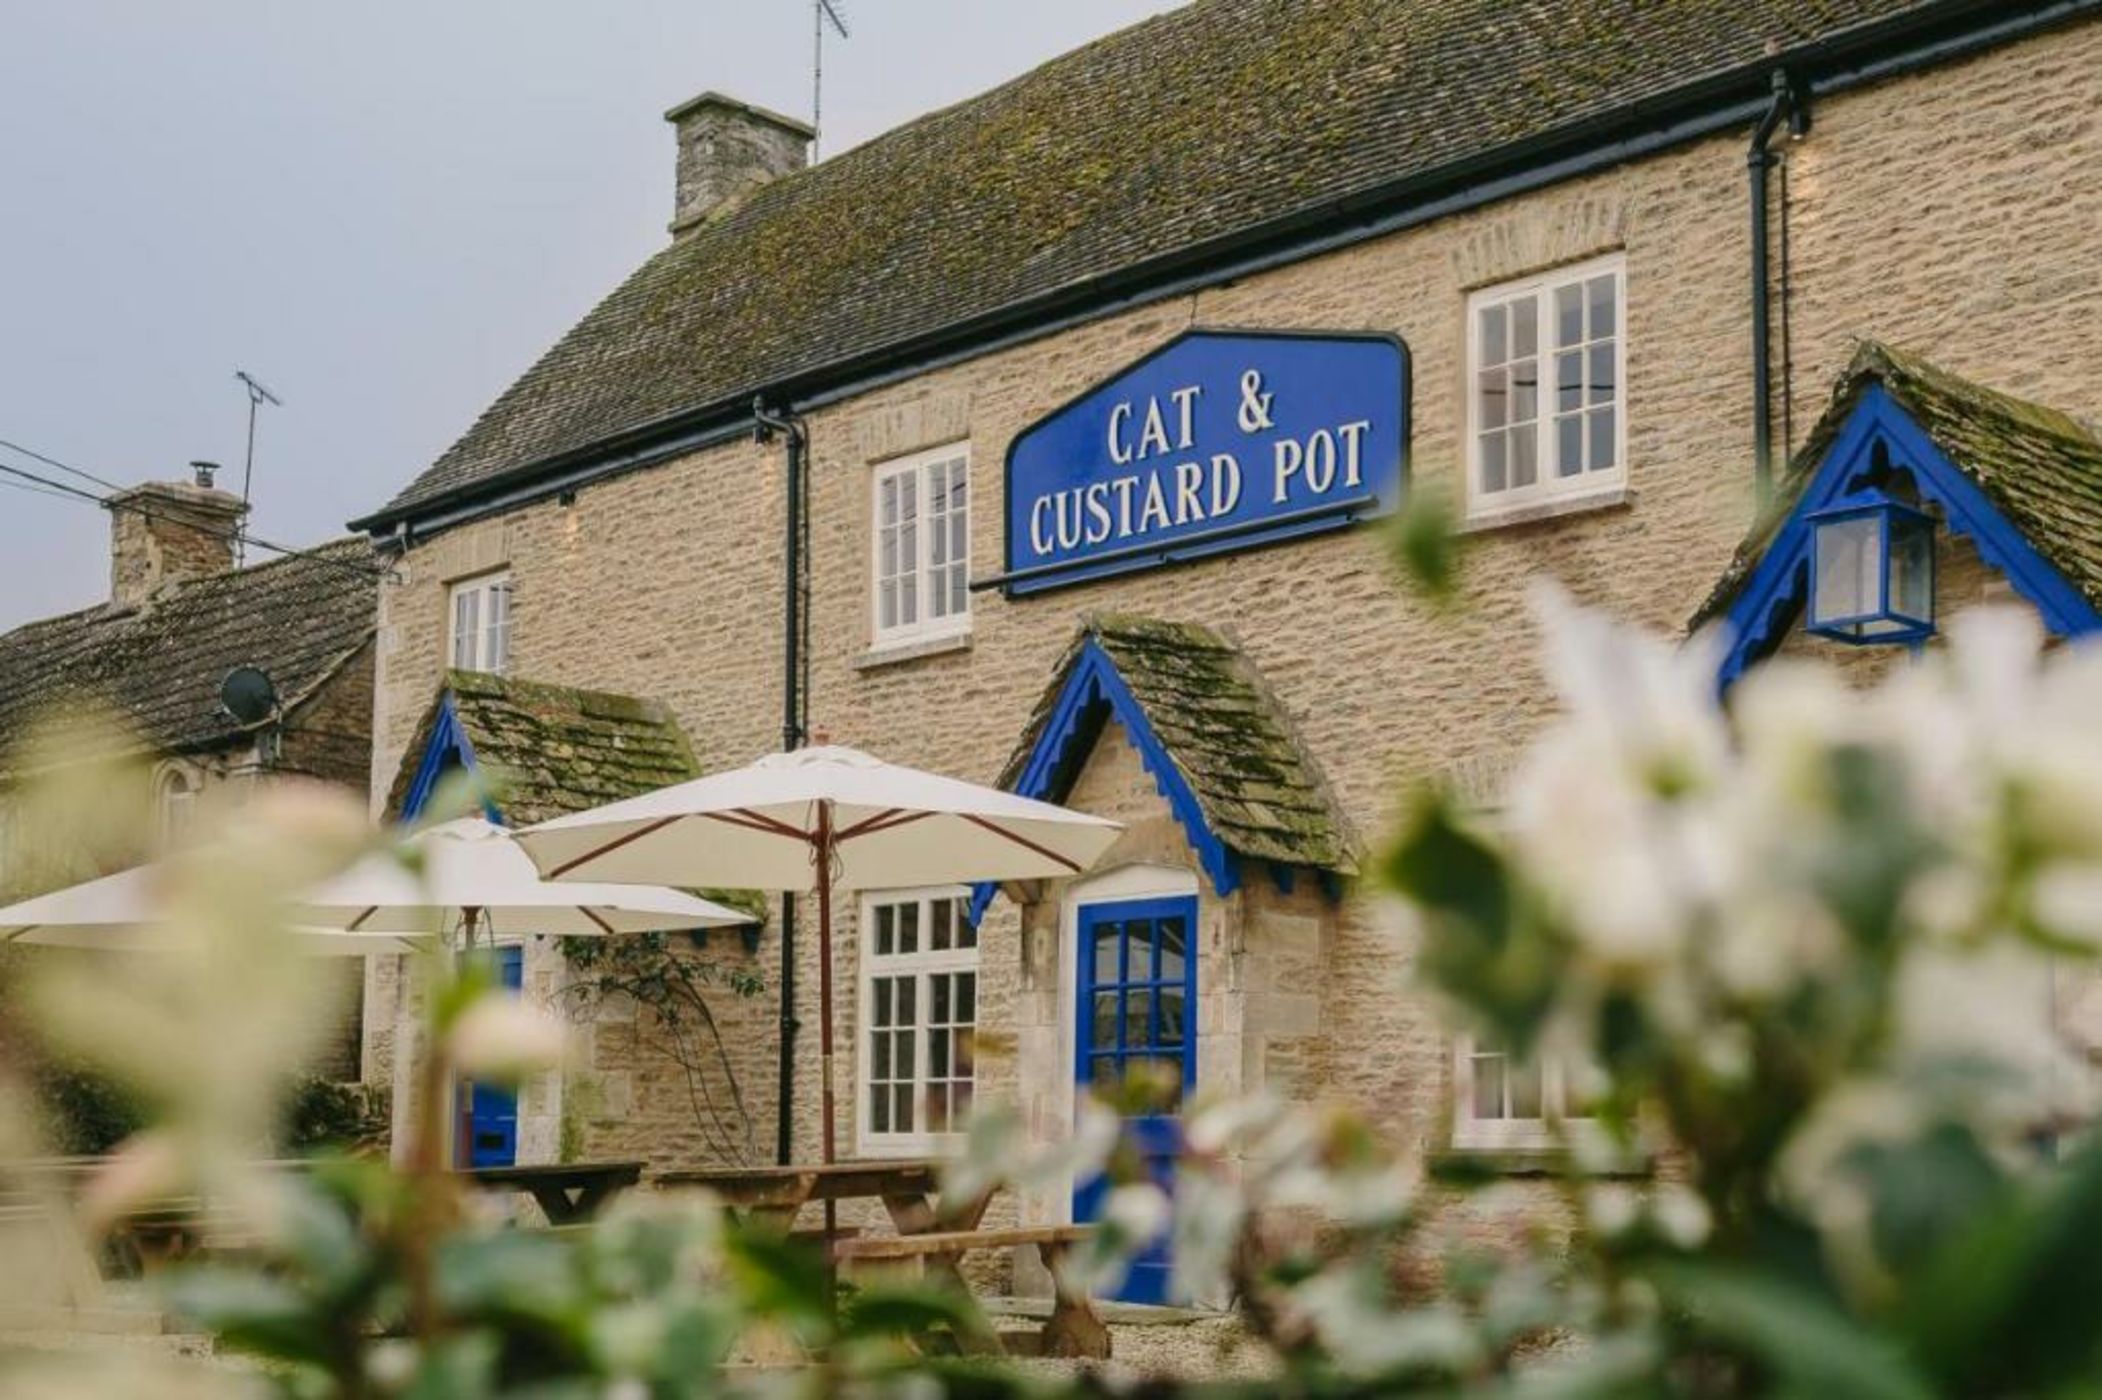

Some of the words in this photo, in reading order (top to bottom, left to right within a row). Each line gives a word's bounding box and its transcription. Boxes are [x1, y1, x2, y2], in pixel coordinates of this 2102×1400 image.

[1108, 386, 1200, 464] CAT
[1238, 369, 1274, 433] &
[1030, 453, 1241, 555] CUSTARD
[1273, 420, 1370, 503] POT
